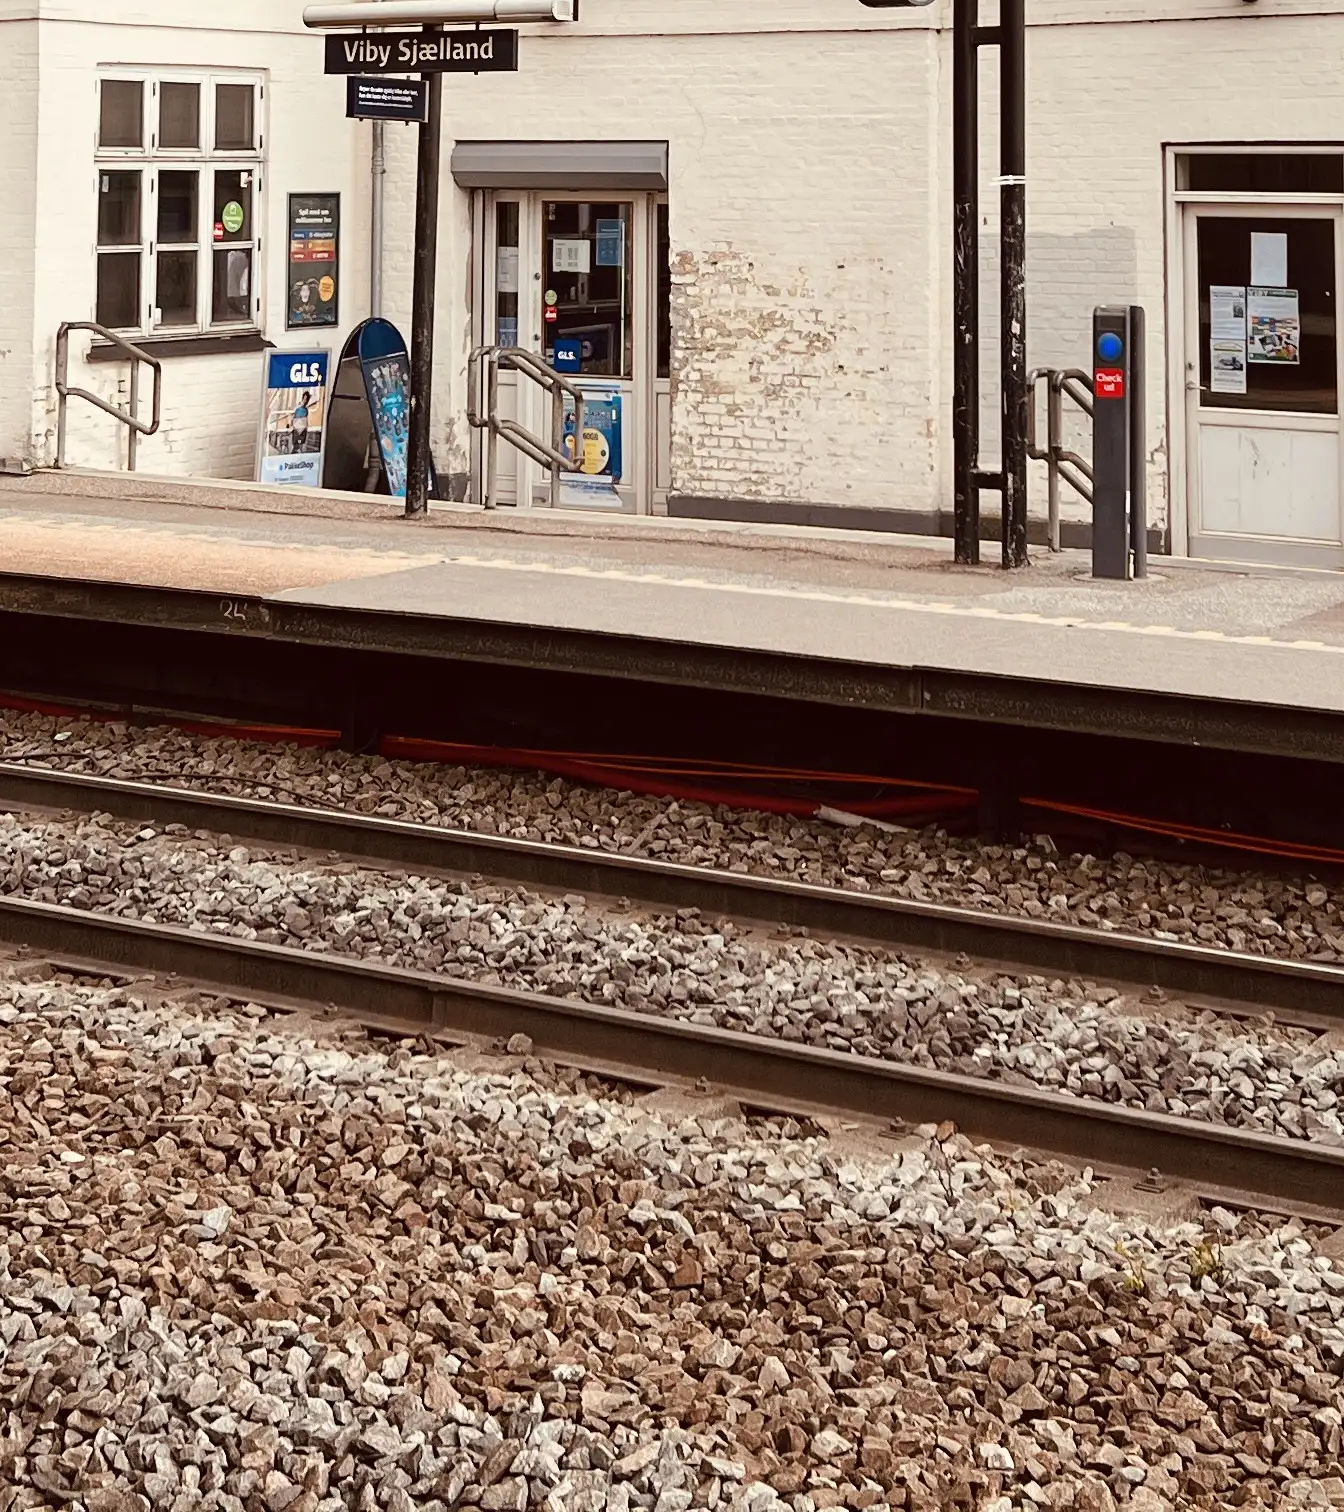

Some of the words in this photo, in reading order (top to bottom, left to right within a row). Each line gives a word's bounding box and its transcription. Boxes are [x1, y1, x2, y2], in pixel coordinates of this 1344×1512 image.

[344, 40, 391, 67] Viby
[398, 36, 493, 66] Sjælland
[1096, 373, 1123, 383] Check
[1103, 383, 1115, 391] ud
